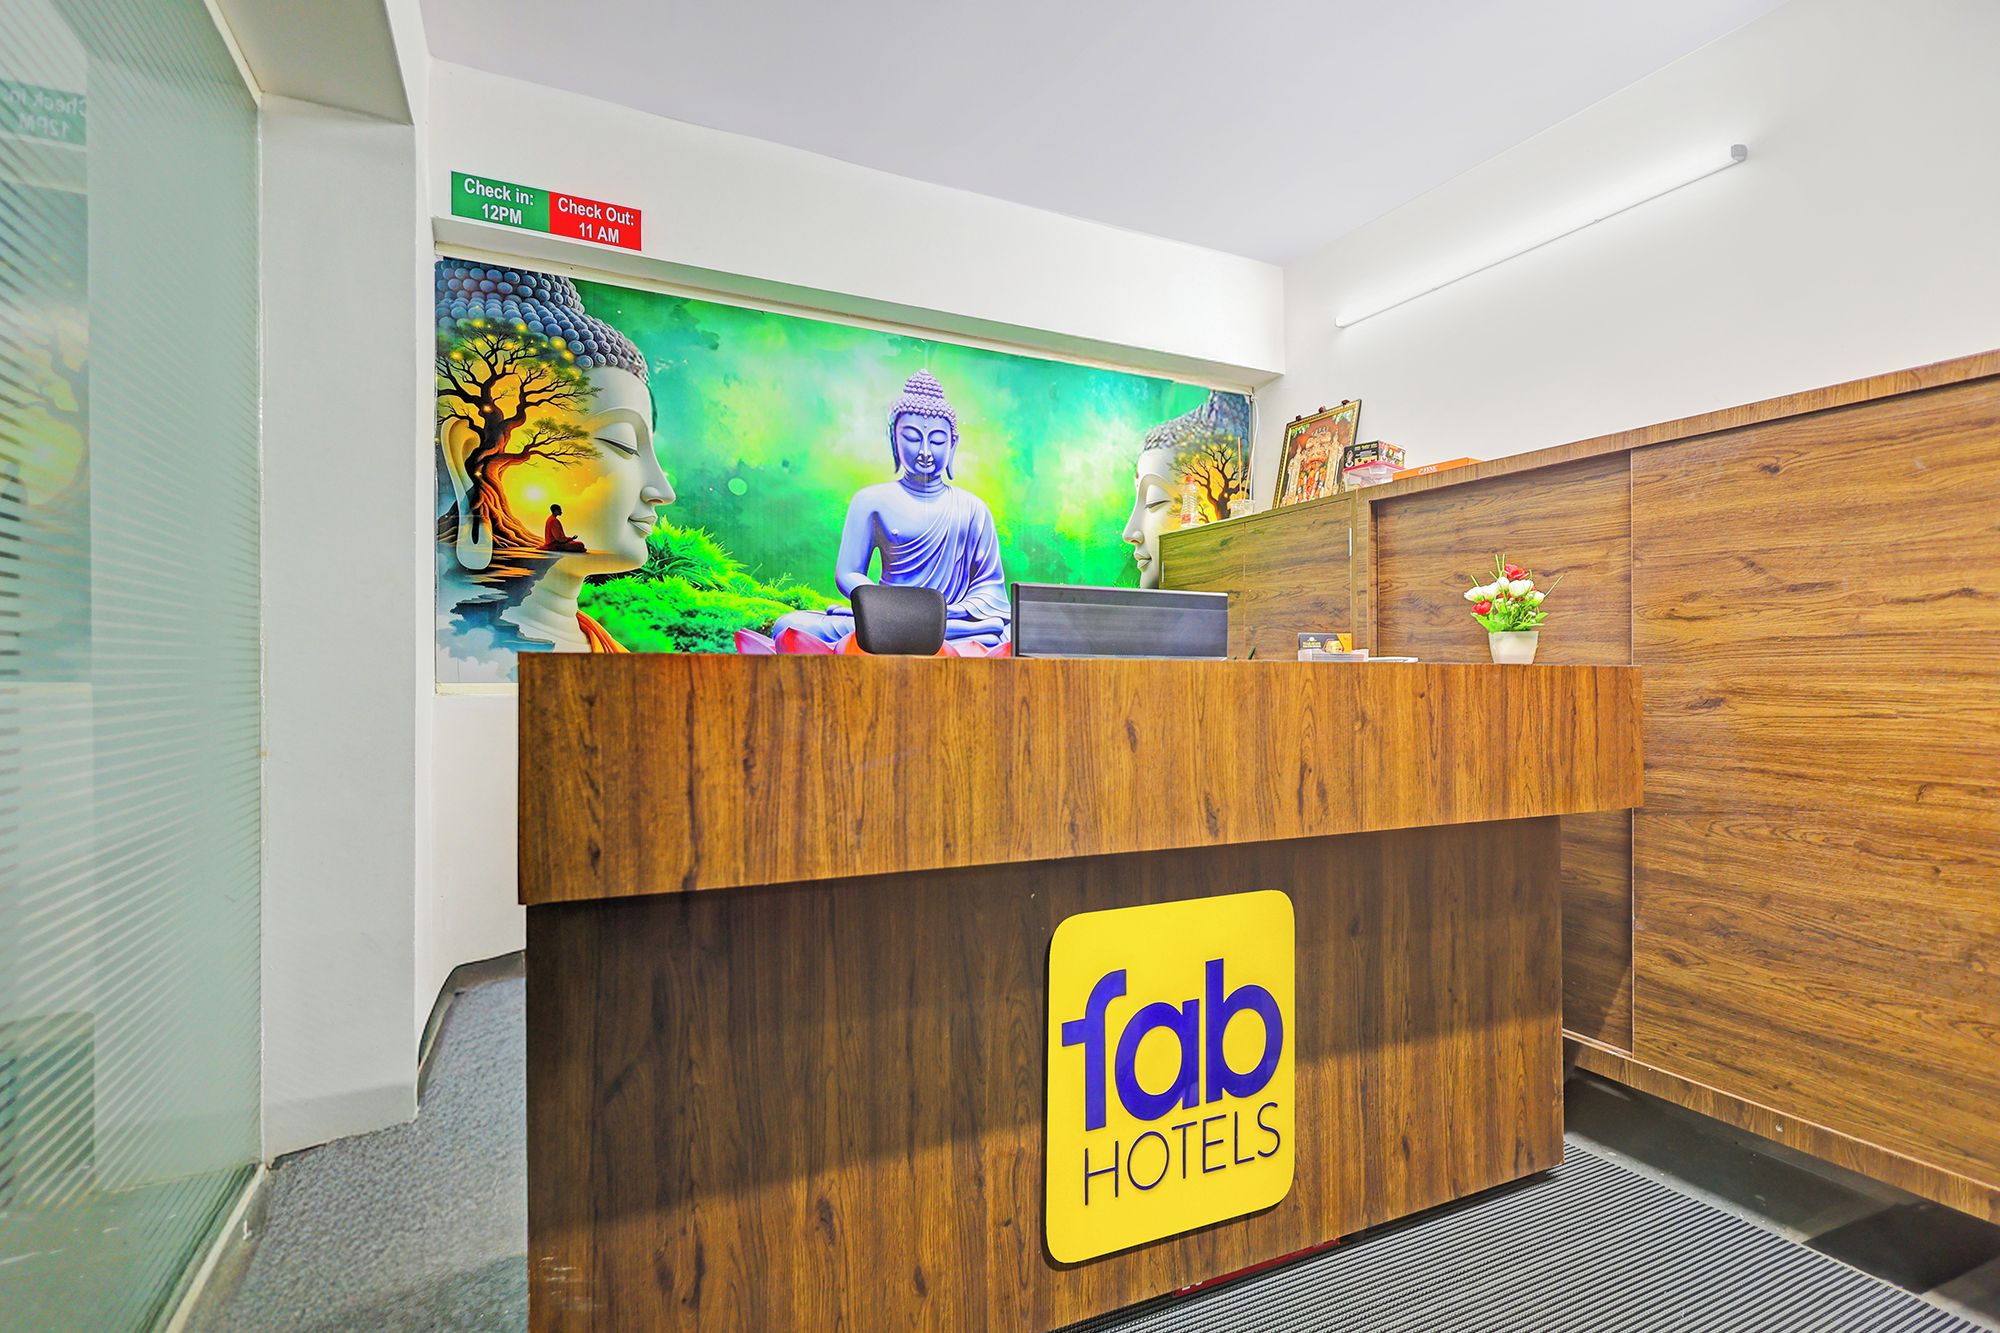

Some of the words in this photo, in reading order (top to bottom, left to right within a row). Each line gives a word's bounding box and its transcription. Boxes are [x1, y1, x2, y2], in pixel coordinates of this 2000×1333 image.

[464, 178, 511, 202] Check
[516, 188, 534, 206] in:
[481, 203, 522, 225] 12PM
[557, 197, 602, 219] Check
[605, 207, 635, 226] Out:
[578, 222, 593, 239] 11
[597, 227, 620, 244] AM
[1062, 958, 1284, 1132] fab
[1084, 1102, 1281, 1206] HOTELS
